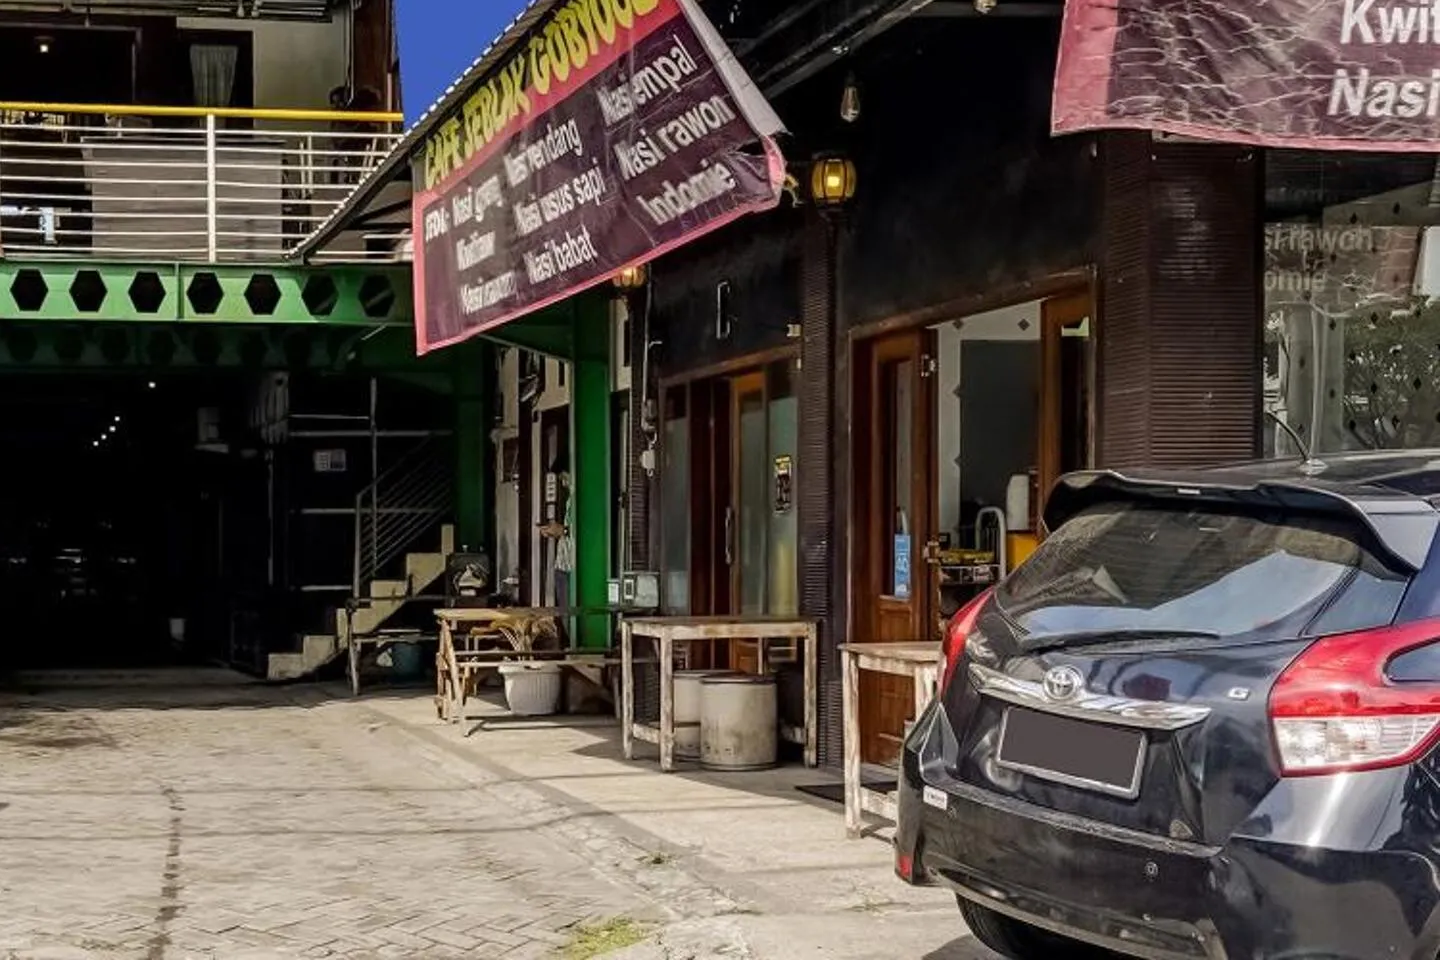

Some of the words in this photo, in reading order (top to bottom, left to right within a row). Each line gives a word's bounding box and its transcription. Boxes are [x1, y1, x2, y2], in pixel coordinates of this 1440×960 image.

[596, 74, 635, 127] Nasi
[632, 34, 698, 104] empal
[1327, 68, 1440, 118] Nasi
[424, 117, 463, 189] CAFE
[526, 118, 583, 172] rendang
[613, 130, 667, 181] Nasi
[656, 94, 736, 154] rawon
[573, 158, 607, 206] sapi
[636, 160, 736, 226] Indomie
[523, 240, 556, 284] Nasi
[551, 224, 598, 272] babat
